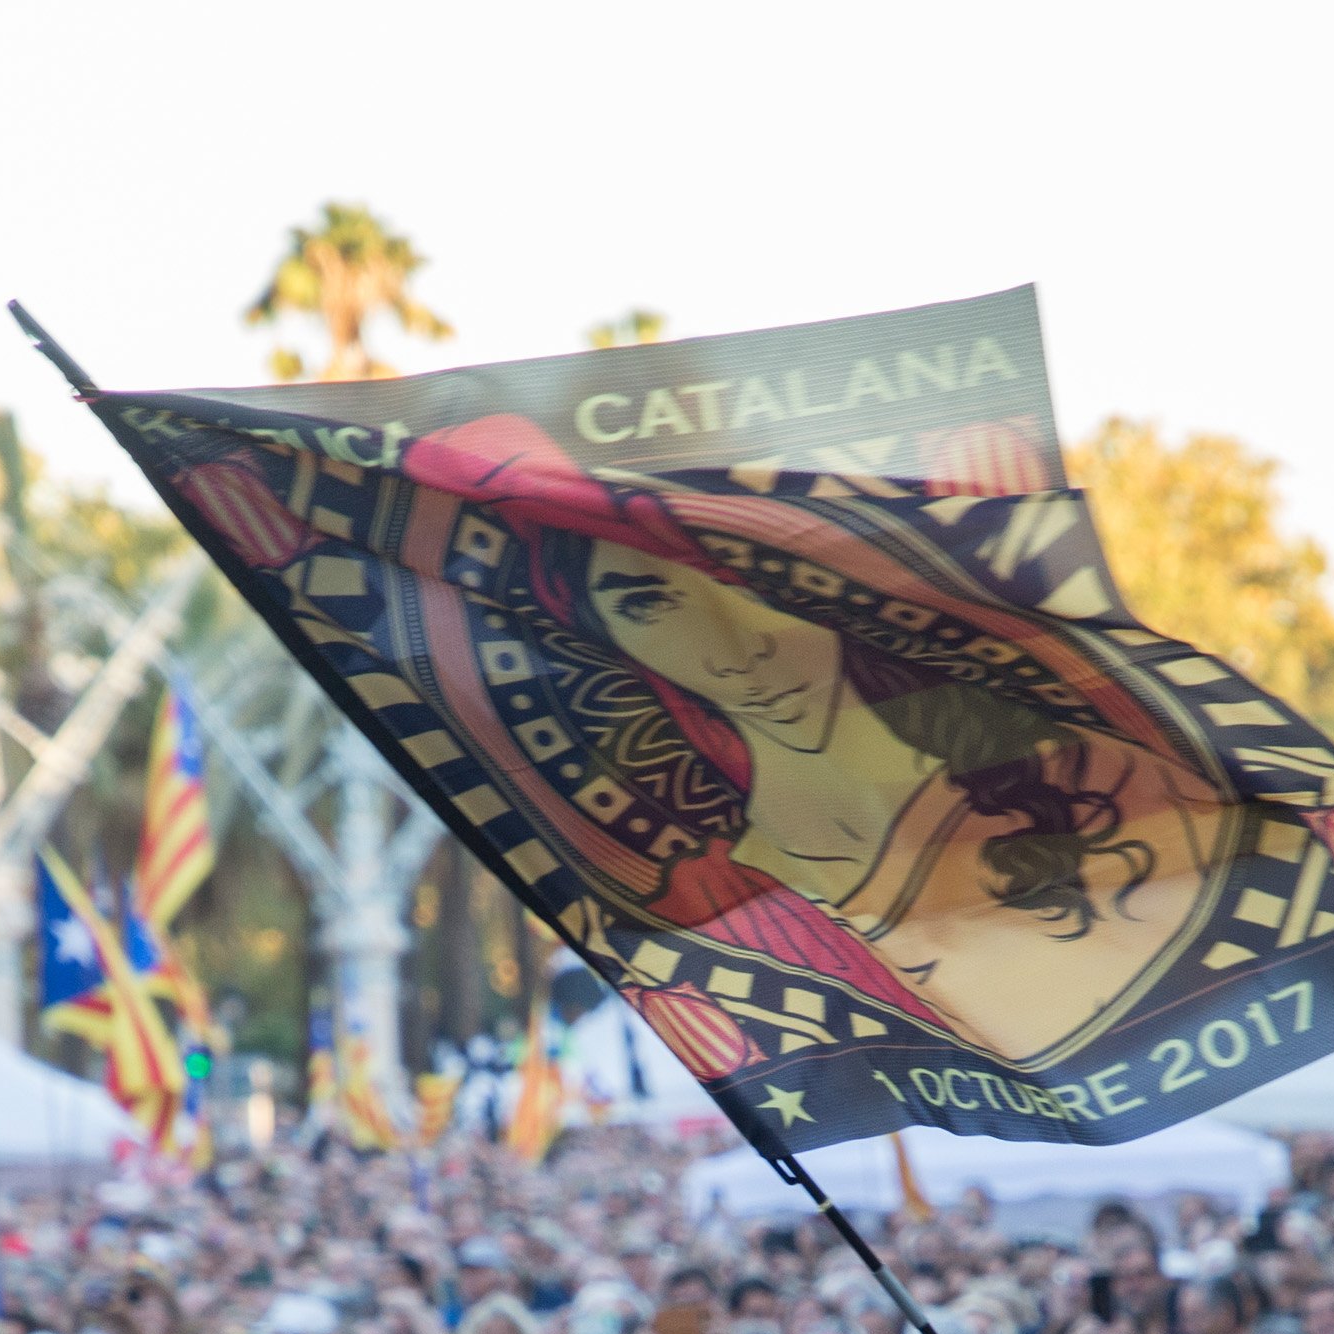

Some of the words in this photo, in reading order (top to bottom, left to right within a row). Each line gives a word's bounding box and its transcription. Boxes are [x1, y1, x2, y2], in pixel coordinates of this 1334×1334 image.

[573, 335, 1022, 445] CATALANA
[872, 1069, 907, 1103] 1
[908, 1062, 1146, 1123] OCTUBRE
[1148, 979, 1315, 1095] 2017
